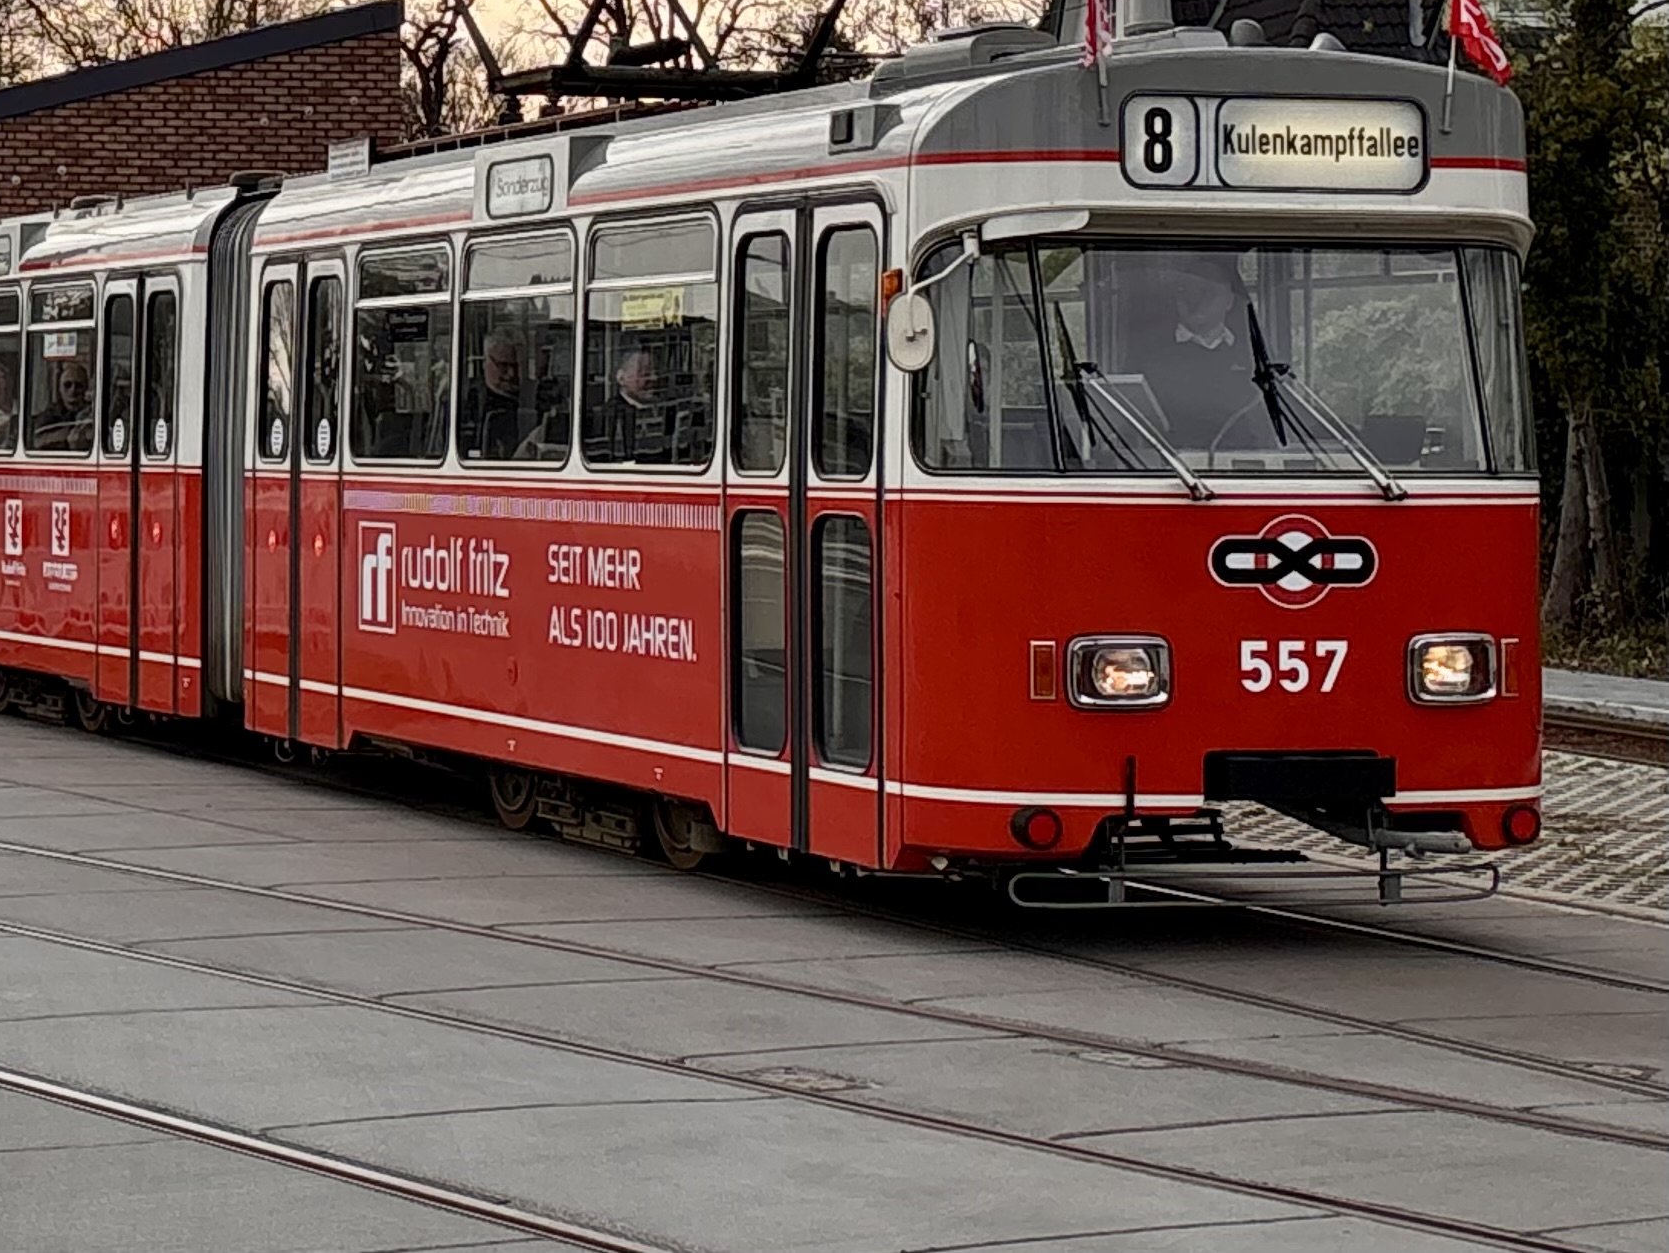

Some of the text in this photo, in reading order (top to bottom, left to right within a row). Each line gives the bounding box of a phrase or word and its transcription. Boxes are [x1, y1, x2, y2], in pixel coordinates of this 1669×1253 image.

[1143, 107, 1420, 174] 8 Kulenkampffallee
[496, 175, 549, 198] Sonderzug
[401, 534, 510, 597] rudolf fritz
[547, 544, 641, 591] SEIT MEHR
[401, 599, 511, 638] Innovation in Technik
[547, 606, 698, 663] ALS 100 JAHREN.
[1240, 639, 1349, 694] 557
